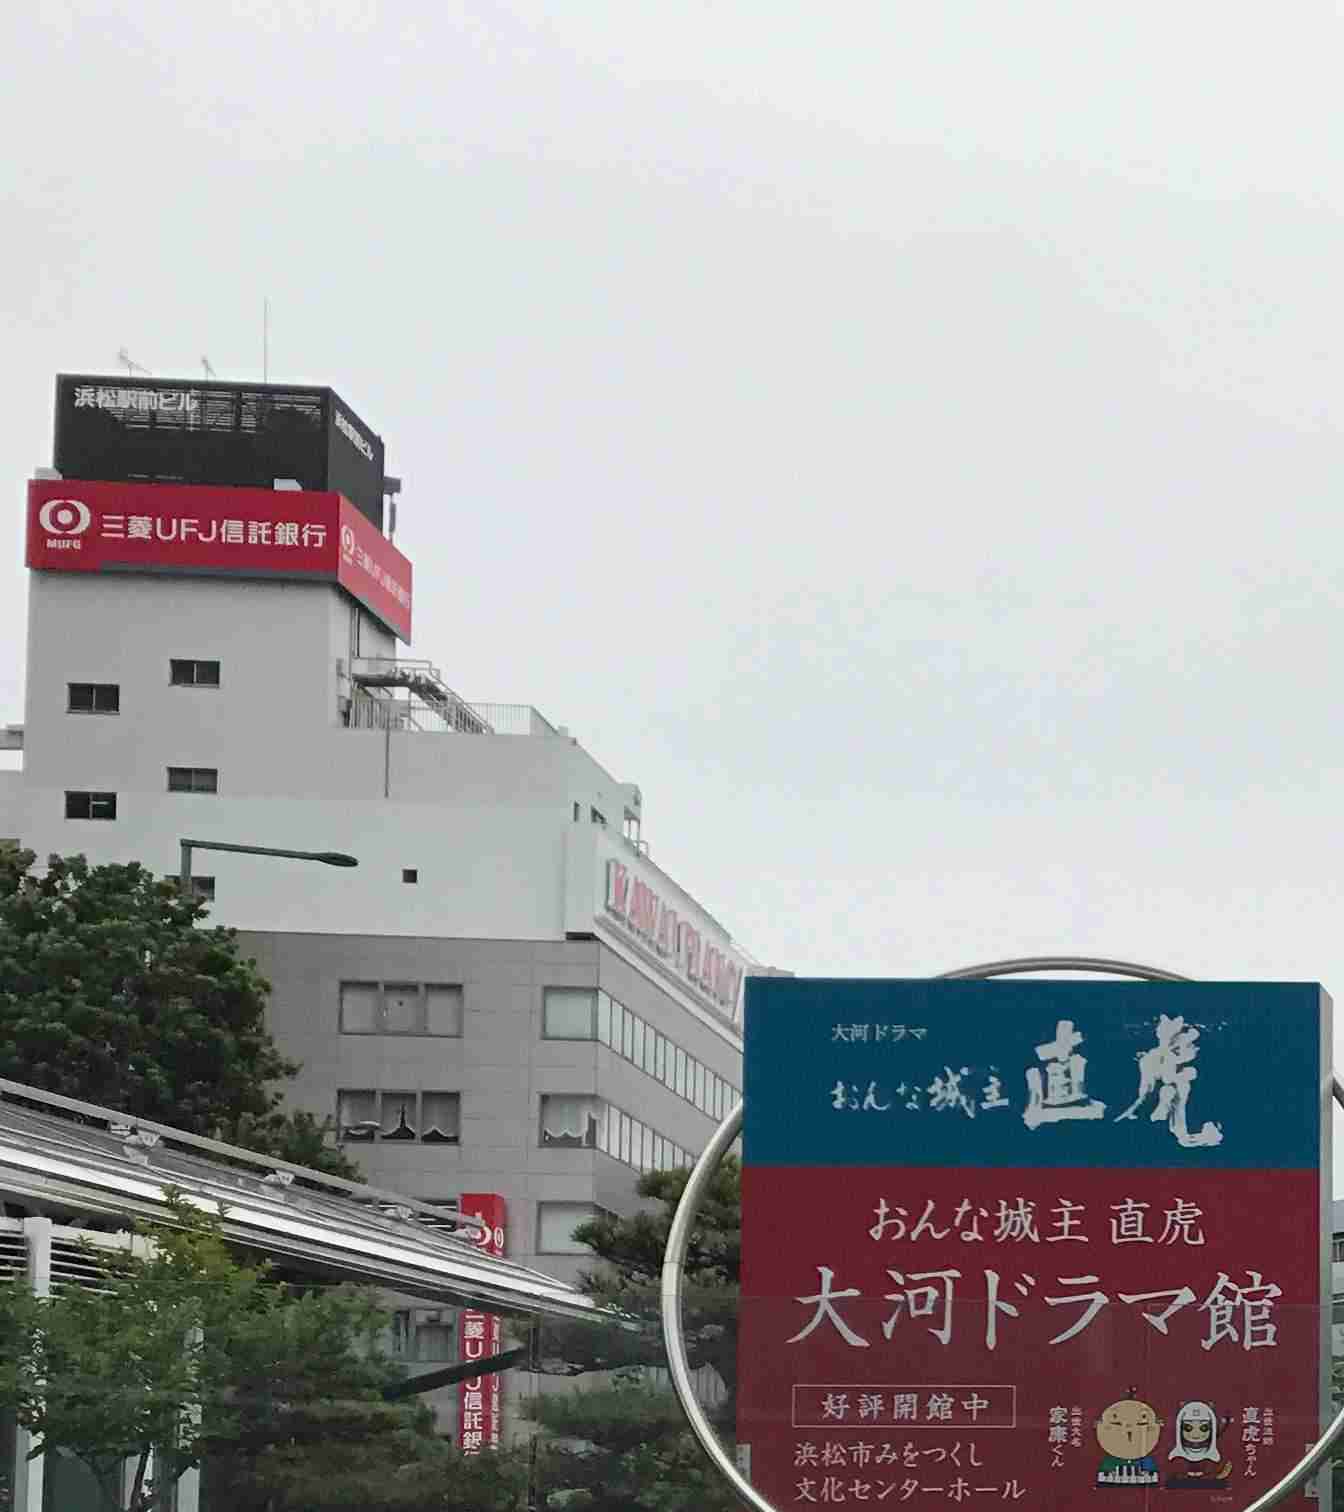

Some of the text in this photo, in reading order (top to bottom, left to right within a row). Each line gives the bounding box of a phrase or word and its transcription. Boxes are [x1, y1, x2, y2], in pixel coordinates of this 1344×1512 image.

[47, 540, 81, 550] MUFG
[101, 513, 327, 549] 三菱UFJ信託銀行
[831, 1023, 928, 1042] 大河ドラマ
[868, 1197, 1206, 1246] おんな城主 直虎
[786, 1265, 1284, 1352] 大河ドラマ館
[821, 1393, 990, 1421] 好評開館中
[793, 1441, 985, 1469] 浜松市みをつくし
[795, 1477, 1027, 1503] 文化センターホール
